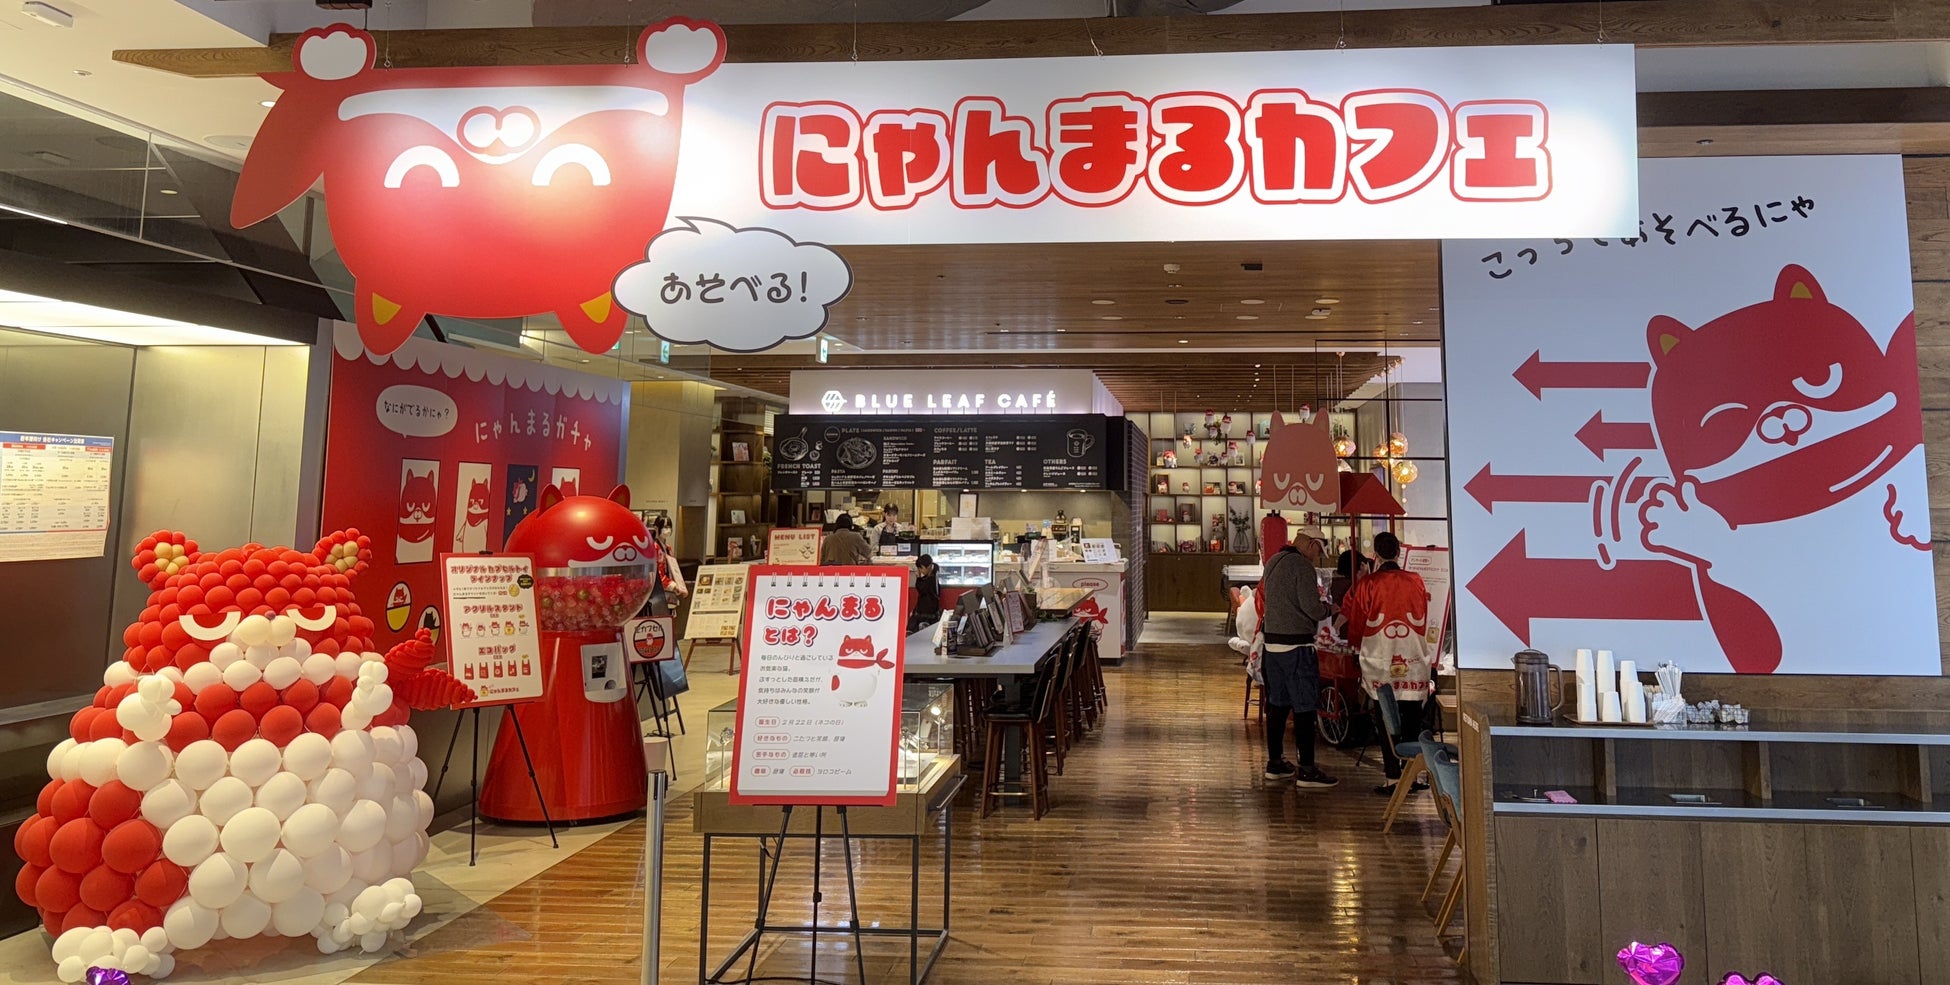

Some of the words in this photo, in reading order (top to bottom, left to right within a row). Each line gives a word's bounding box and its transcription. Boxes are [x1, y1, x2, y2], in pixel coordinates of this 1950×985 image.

[758, 88, 1554, 211] にゃんまるカフェ
[659, 271, 809, 307] あそべる!
[383, 399, 450, 420] なにがでるかにゃ?
[854, 393, 913, 408] BLUE
[927, 393, 985, 408] LEAF
[997, 390, 1057, 408] CAFÉ
[475, 408, 592, 451] にゃんまるガチャ
[766, 593, 884, 621] にゃんまる
[763, 624, 818, 647] とは?
